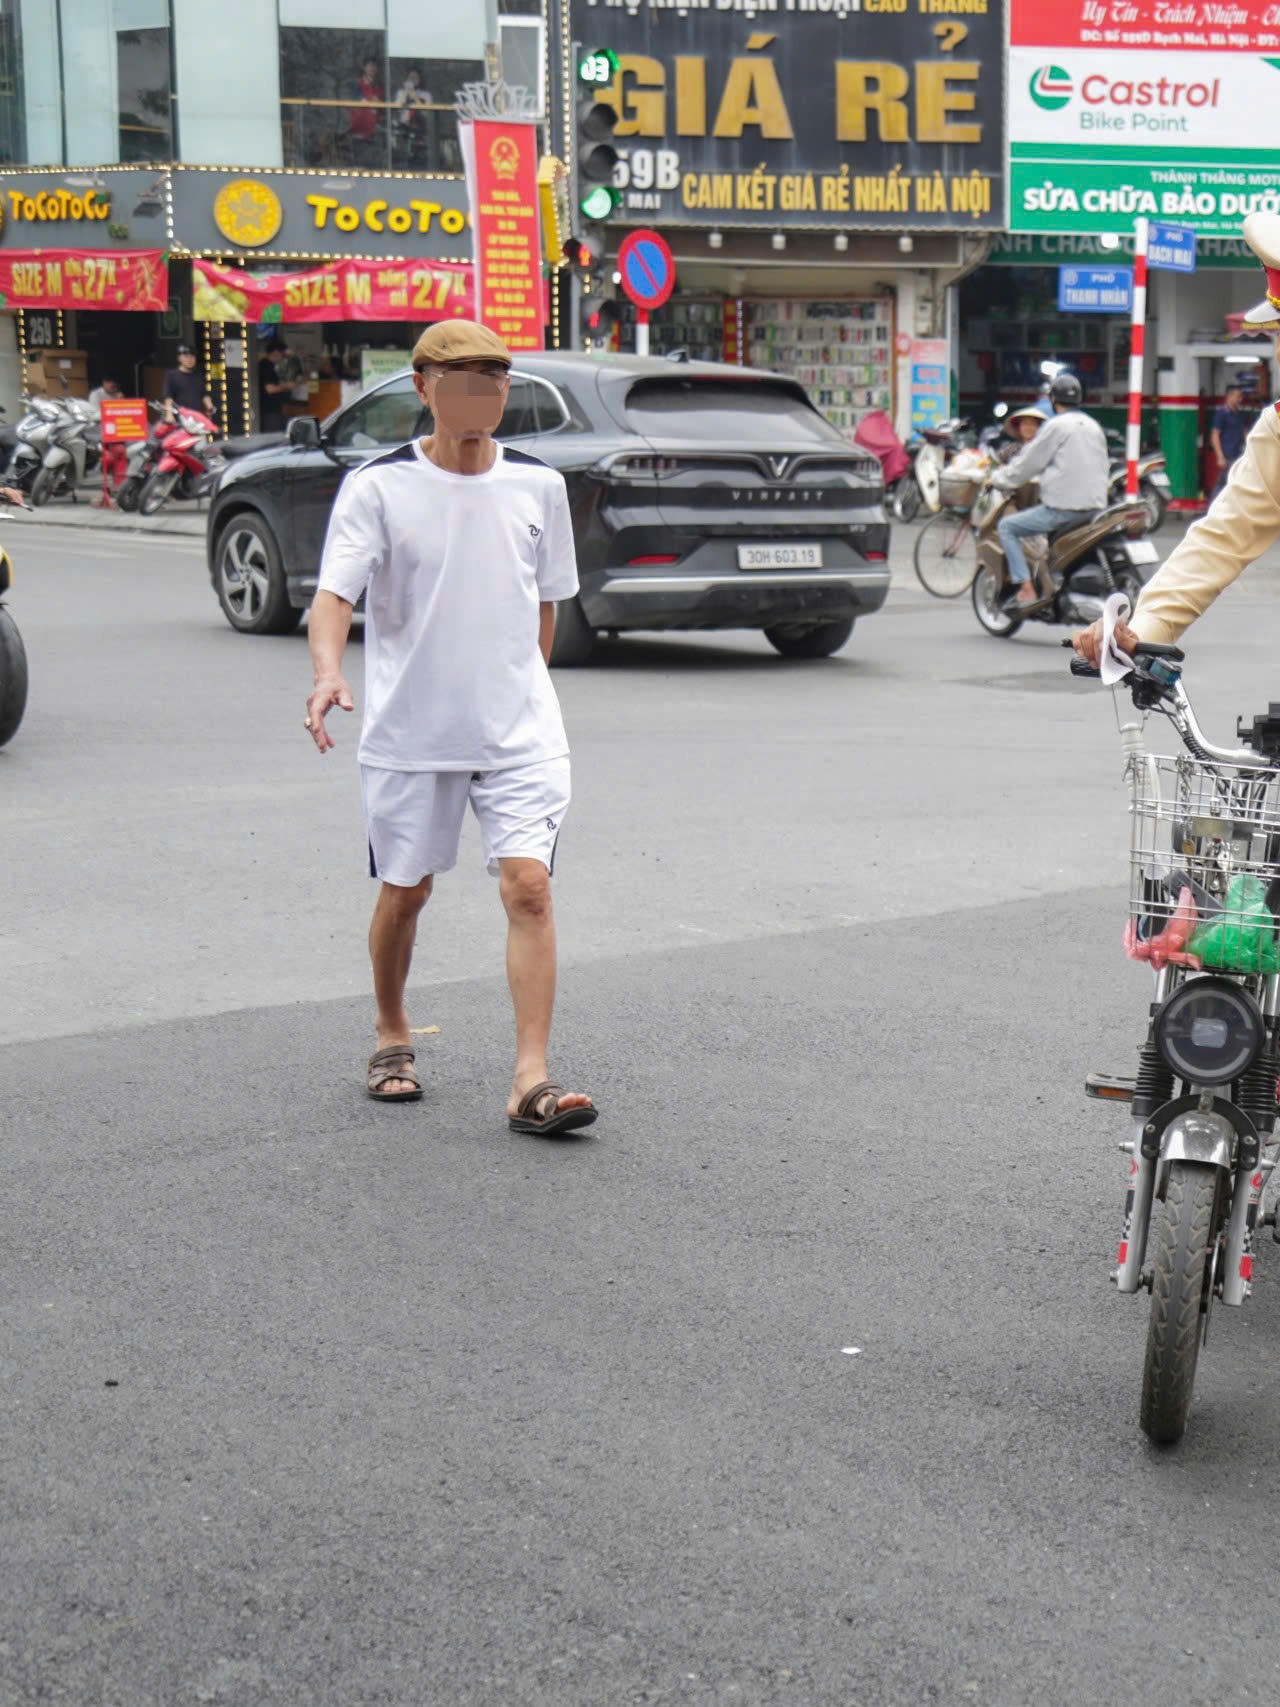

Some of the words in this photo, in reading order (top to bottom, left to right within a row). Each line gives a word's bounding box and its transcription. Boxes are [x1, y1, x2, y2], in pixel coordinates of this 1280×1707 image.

[592, 34, 794, 140] GIÁ
[836, 22, 981, 143] RẺ
[1081, 74, 1221, 108] Castrol
[1080, 112, 1125, 131] Bike
[1131, 113, 1188, 133] Point
[682, 173, 733, 209] CAM
[736, 161, 776, 210] KẾT
[780, 171, 817, 211] GIÁ
[821, 163, 850, 211] RẺ
[854, 163, 911, 212] NHẤT
[915, 170, 947, 213] HÀ
[951, 168, 991, 219] NỘI
[1023, 181, 1080, 212] SỬA
[1082, 185, 1158, 214] CHỮA
[1162, 185, 1216, 216] BẢO
[285, 274, 341, 306] SIZE
[346, 273, 372, 305] M
[732, 490, 824, 501] VINFAST
